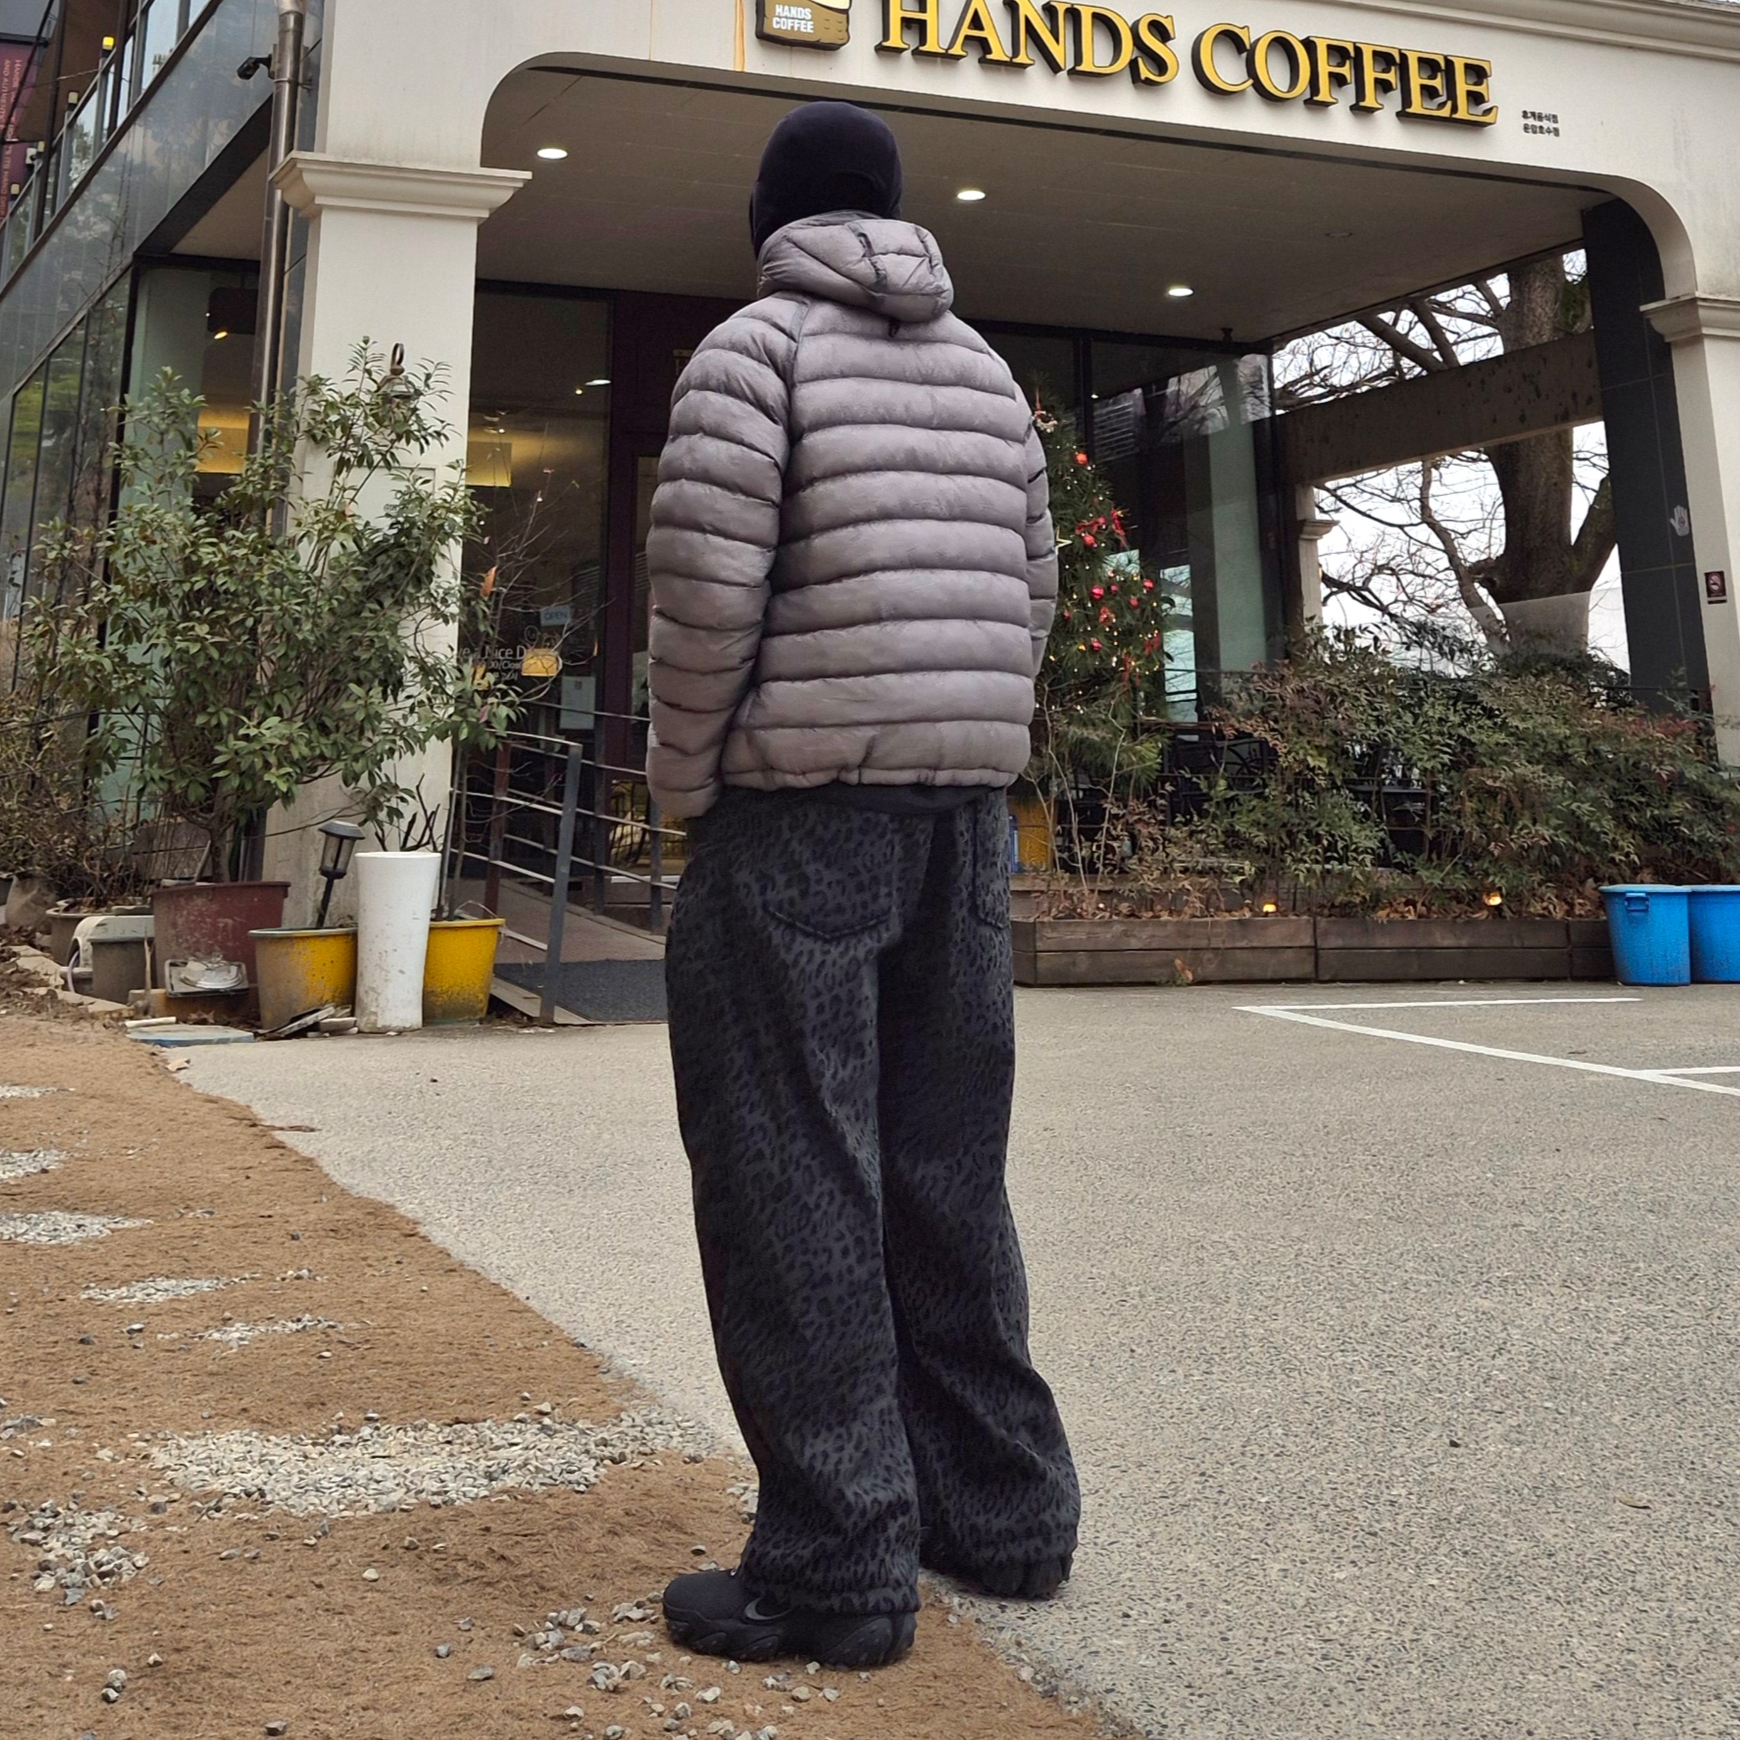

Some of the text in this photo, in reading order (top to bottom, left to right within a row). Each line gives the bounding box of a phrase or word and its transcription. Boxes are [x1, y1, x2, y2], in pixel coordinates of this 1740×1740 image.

[775, 4, 812, 20] HANDS
[772, 17, 814, 33] COFFEE
[875, 0, 1498, 128] HANDS COFFEE
[544, 610, 568, 620] OPEN
